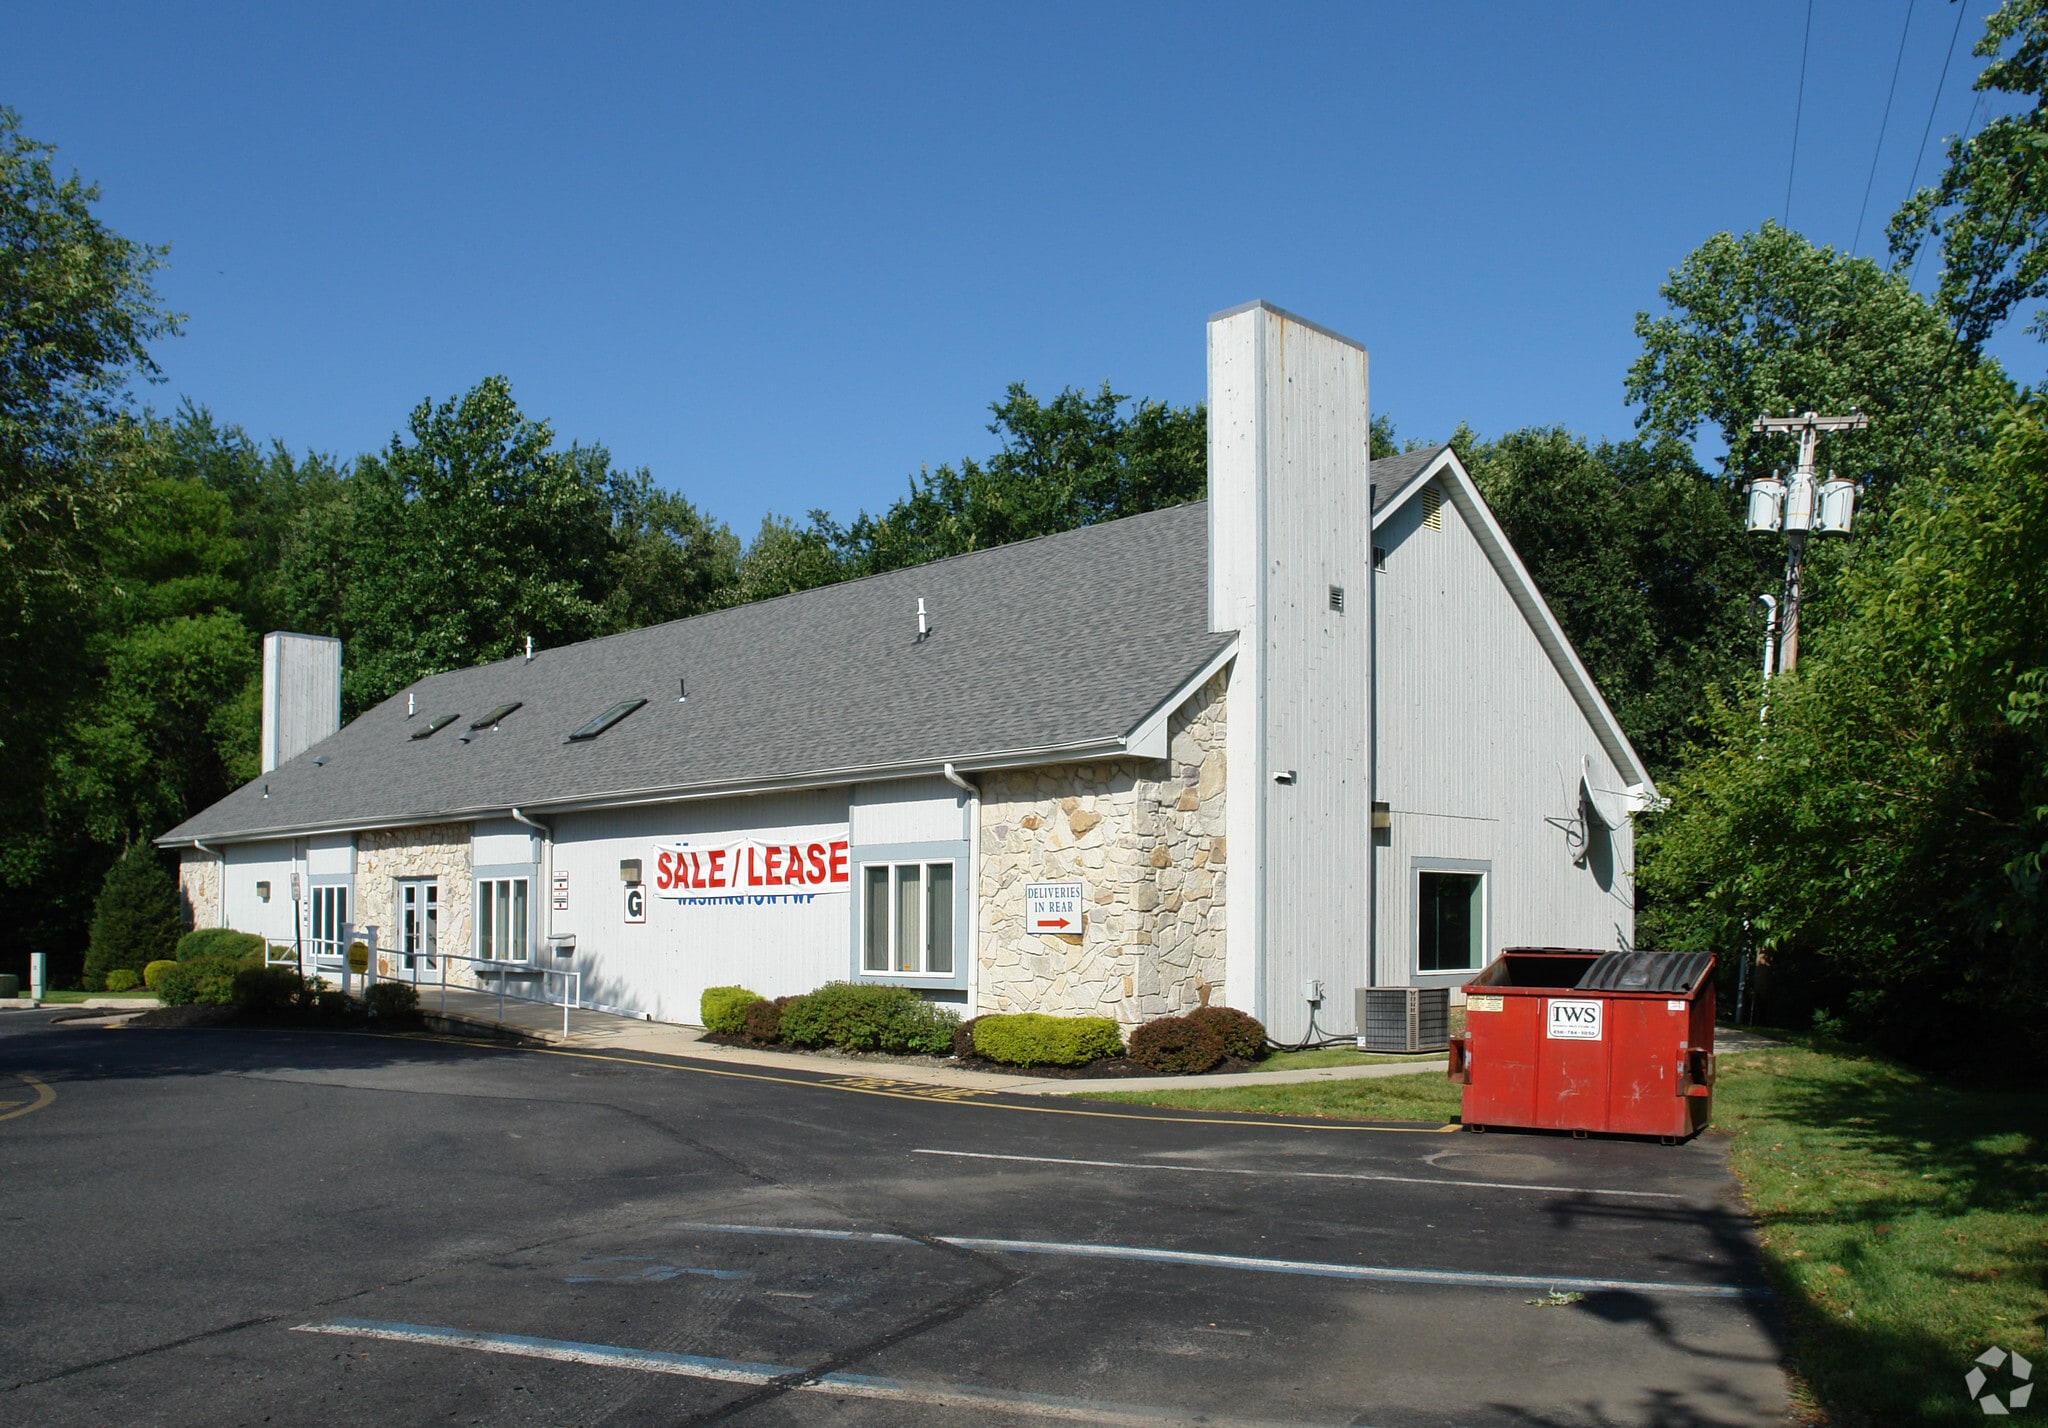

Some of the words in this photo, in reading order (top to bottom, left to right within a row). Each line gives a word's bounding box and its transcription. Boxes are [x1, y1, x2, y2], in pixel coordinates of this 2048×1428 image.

[1028, 887, 1080, 898] DELIVERIES
[627, 890, 642, 917] G
[1034, 902, 1044, 912] IN
[1049, 902, 1073, 912] REAR
[1553, 1006, 1596, 1023] IWS
